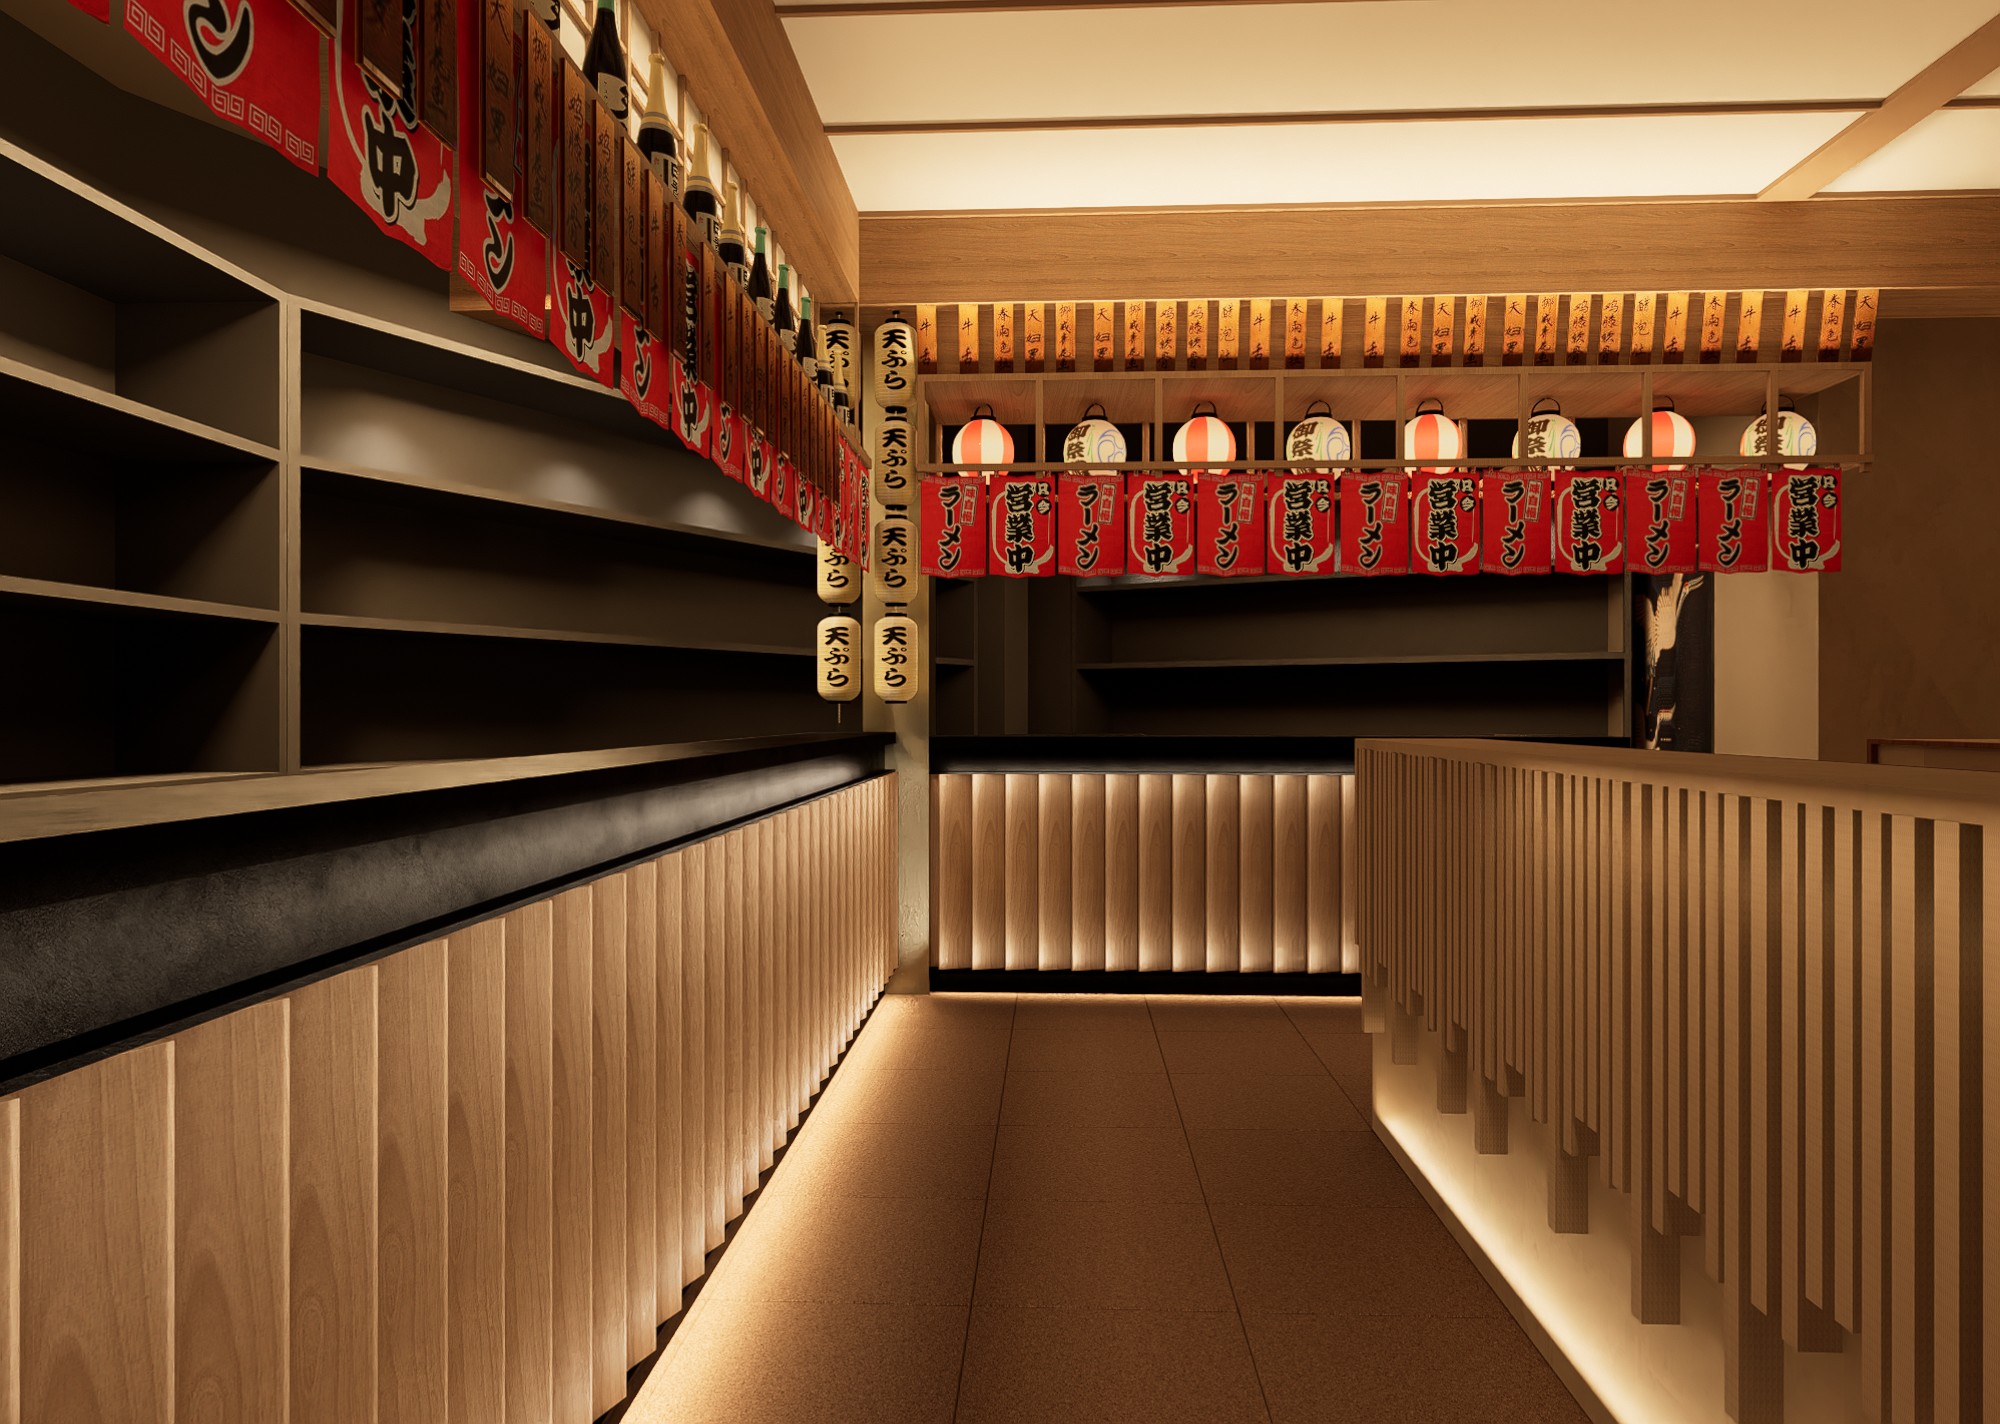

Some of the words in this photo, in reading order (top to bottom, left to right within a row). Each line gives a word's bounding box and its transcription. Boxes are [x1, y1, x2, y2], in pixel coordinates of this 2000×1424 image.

[881, 328, 908, 390] 天ぷら
[881, 427, 908, 490] 天ぷら
[881, 527, 908, 588] 天ぷら
[938, 483, 963, 570] ラーメン
[1004, 481, 1035, 573] 営業中
[1076, 483, 1101, 570] ラーメン
[1143, 480, 1174, 572] 営業中
[1215, 482, 1239, 569] ラーメン
[1283, 480, 1314, 572] 営業中
[1359, 482, 1383, 569] ラーメン
[1427, 478, 1458, 571] 営業中
[1501, 481, 1525, 568] ラーメン
[1571, 478, 1602, 570] 営業中
[1645, 479, 1669, 568] ラーメン
[1717, 479, 1742, 568] ラーメン
[1788, 477, 1820, 569] 営業中
[824, 627, 850, 687] 天ぷら
[881, 627, 908, 687] 天ぷら
